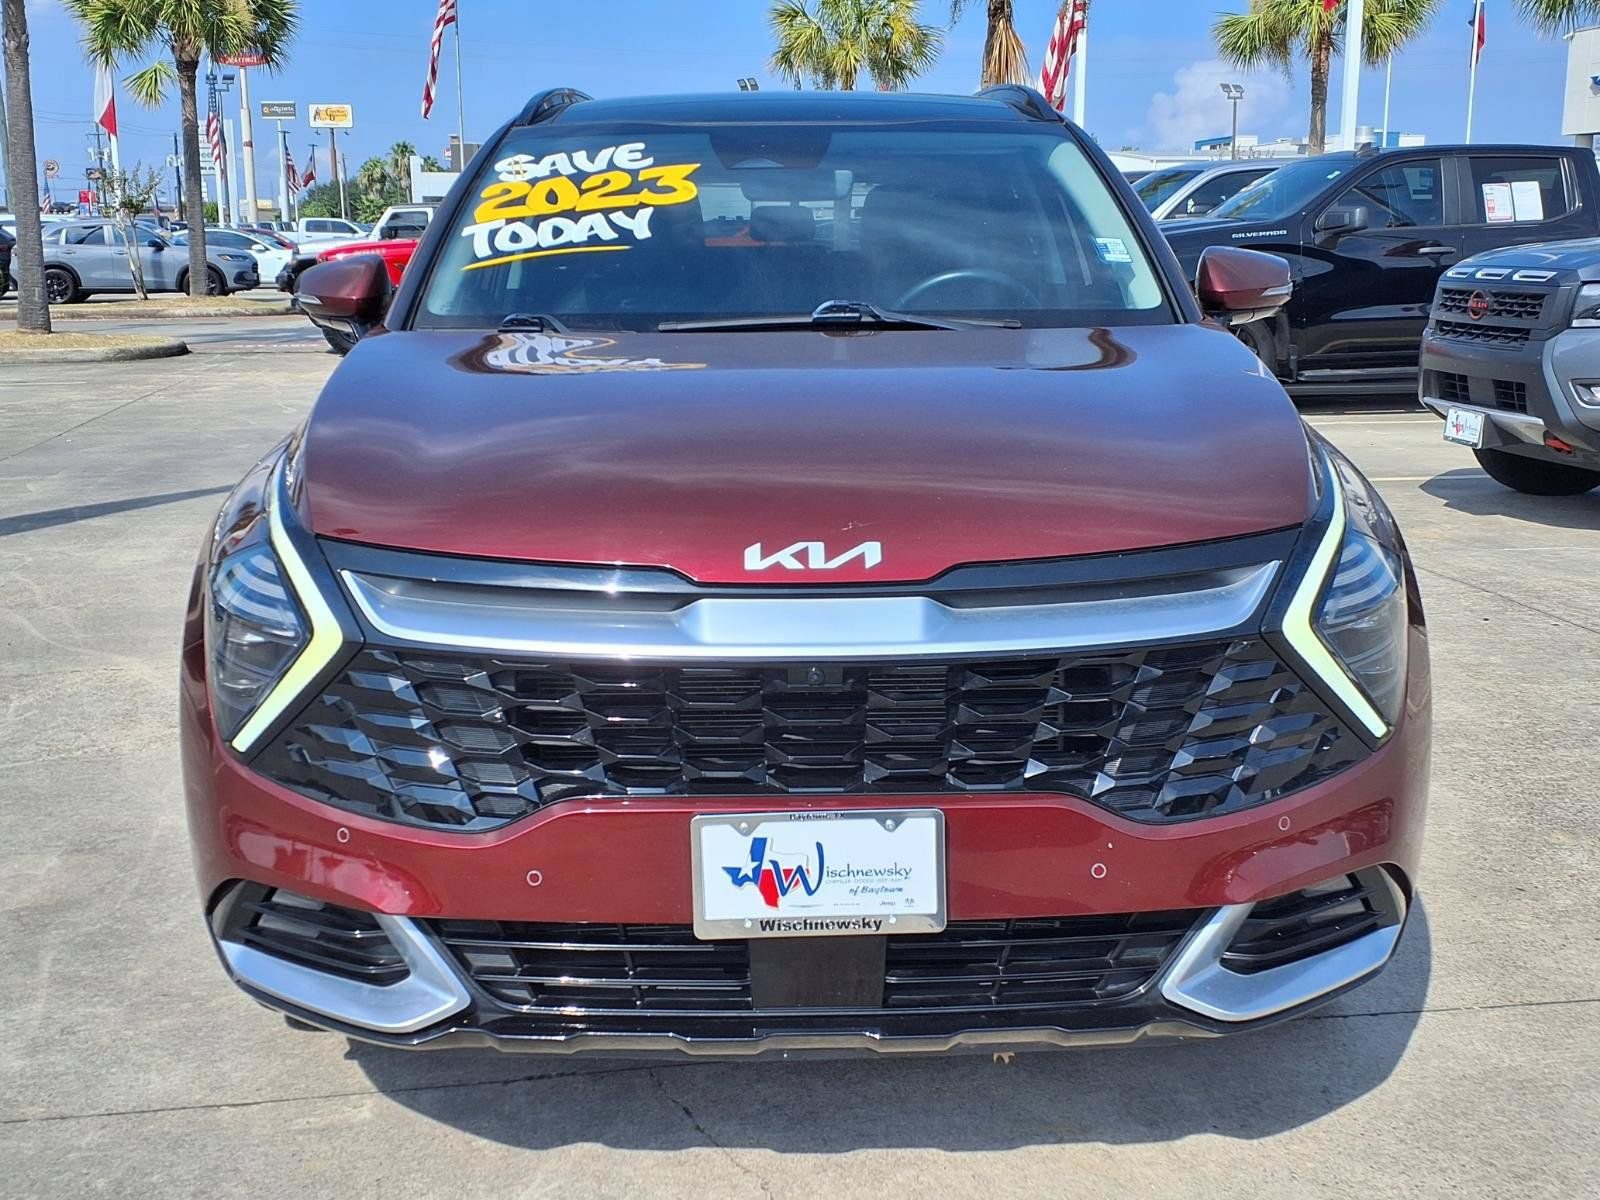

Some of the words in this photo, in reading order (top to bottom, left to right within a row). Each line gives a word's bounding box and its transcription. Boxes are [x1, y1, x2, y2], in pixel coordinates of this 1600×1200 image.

[473, 163, 701, 224] 2023
[461, 207, 654, 259] TODAY
[1231, 229, 1287, 239] SILVERADO
[744, 541, 882, 570] KIA
[759, 917, 882, 932] Wischnewsky
